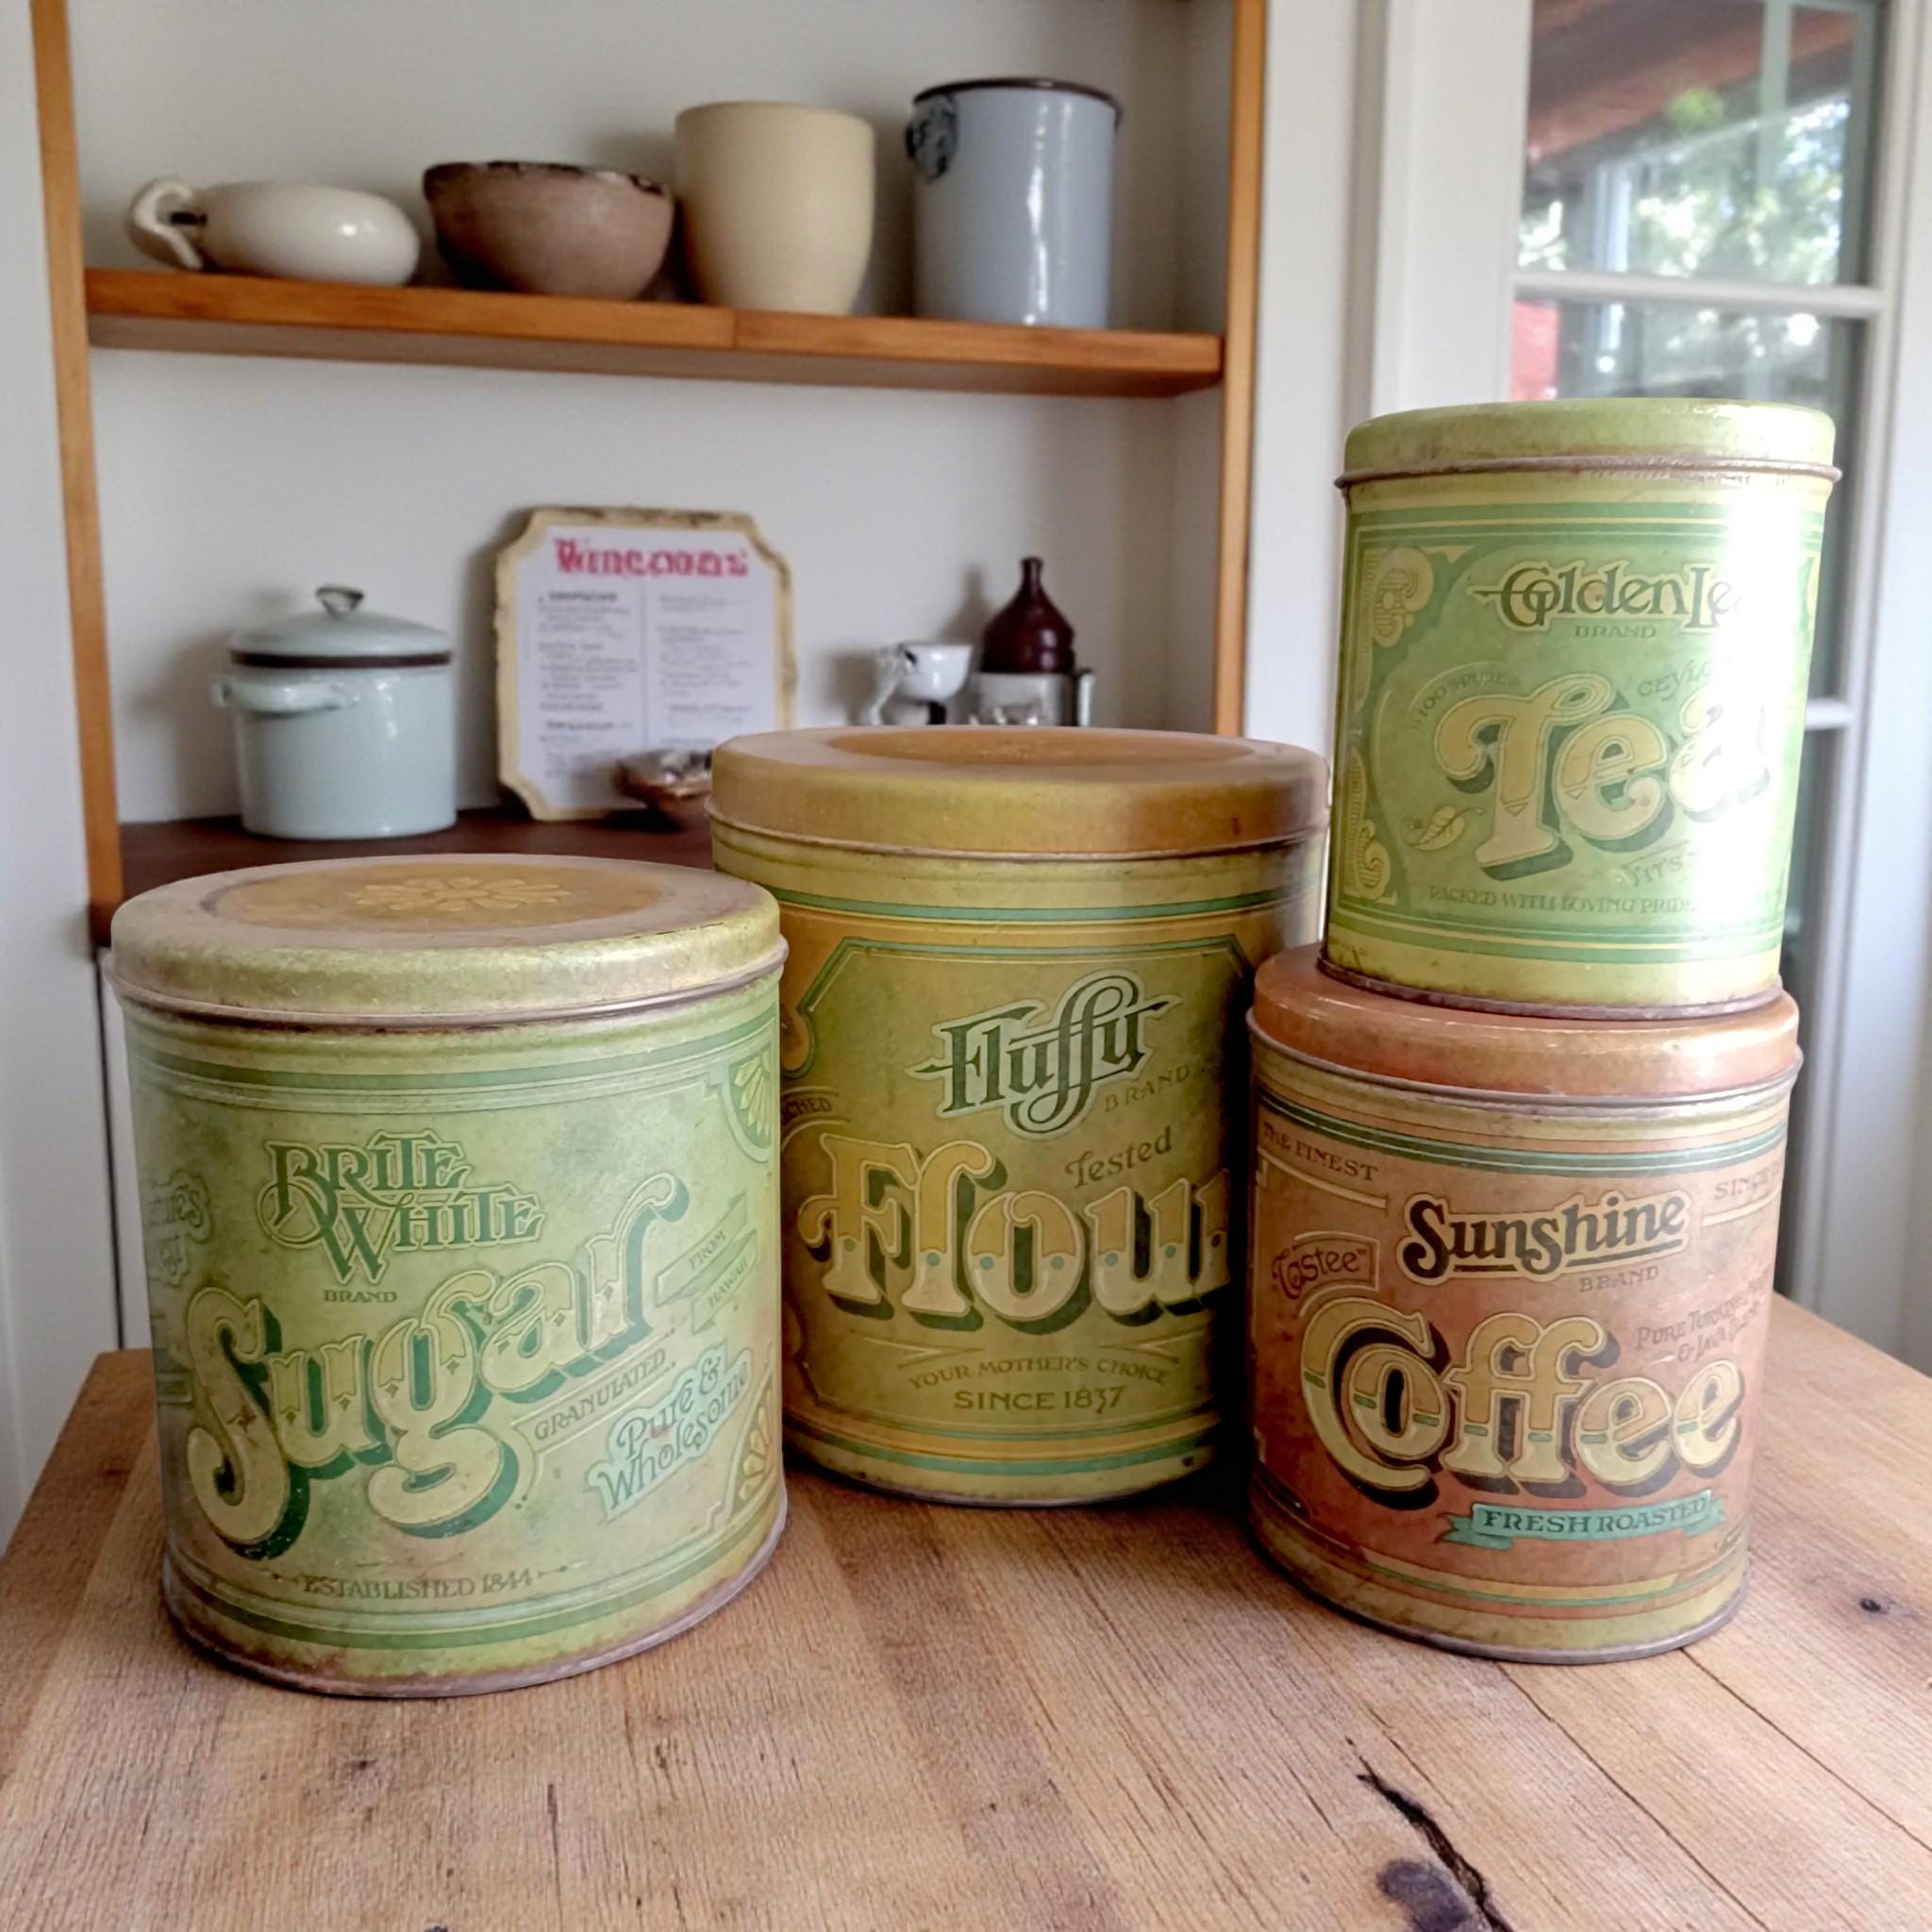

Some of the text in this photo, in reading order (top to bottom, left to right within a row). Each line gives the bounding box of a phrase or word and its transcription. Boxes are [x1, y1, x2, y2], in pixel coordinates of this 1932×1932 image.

[1474, 566, 1690, 627] Golden
[1574, 625, 1657, 639] BRAND
[1433, 673, 1771, 881] Tea
[1502, 893, 1557, 910] WITH
[913, 974, 1170, 1134] Fluffy
[1104, 1064, 1191, 1113] BRAND
[266, 1134, 470, 1231] BRITE
[1064, 1126, 1174, 1189] Tested
[1263, 1121, 1379, 1182] THE FINEST
[304, 1184, 542, 1280] WHITE
[1403, 1197, 1686, 1276] Sunshine
[324, 1289, 397, 1304] BRAND
[1578, 1265, 1660, 1293] BRAND
[189, 1173, 691, 1561] Sugar
[534, 1347, 667, 1441] GRANULATED
[908, 1356, 1171, 1389] YOUR MOTHER'S CHOICE
[616, 1356, 722, 1459] Pure &
[953, 1386, 1125, 1414] SINCE 1837
[1301, 1296, 1745, 1511] Coffee
[597, 1361, 748, 1509] Wholesome
[1483, 1497, 1709, 1534] FRESH ROASTED
[303, 1568, 533, 1600] ESTABLISHED 1844
